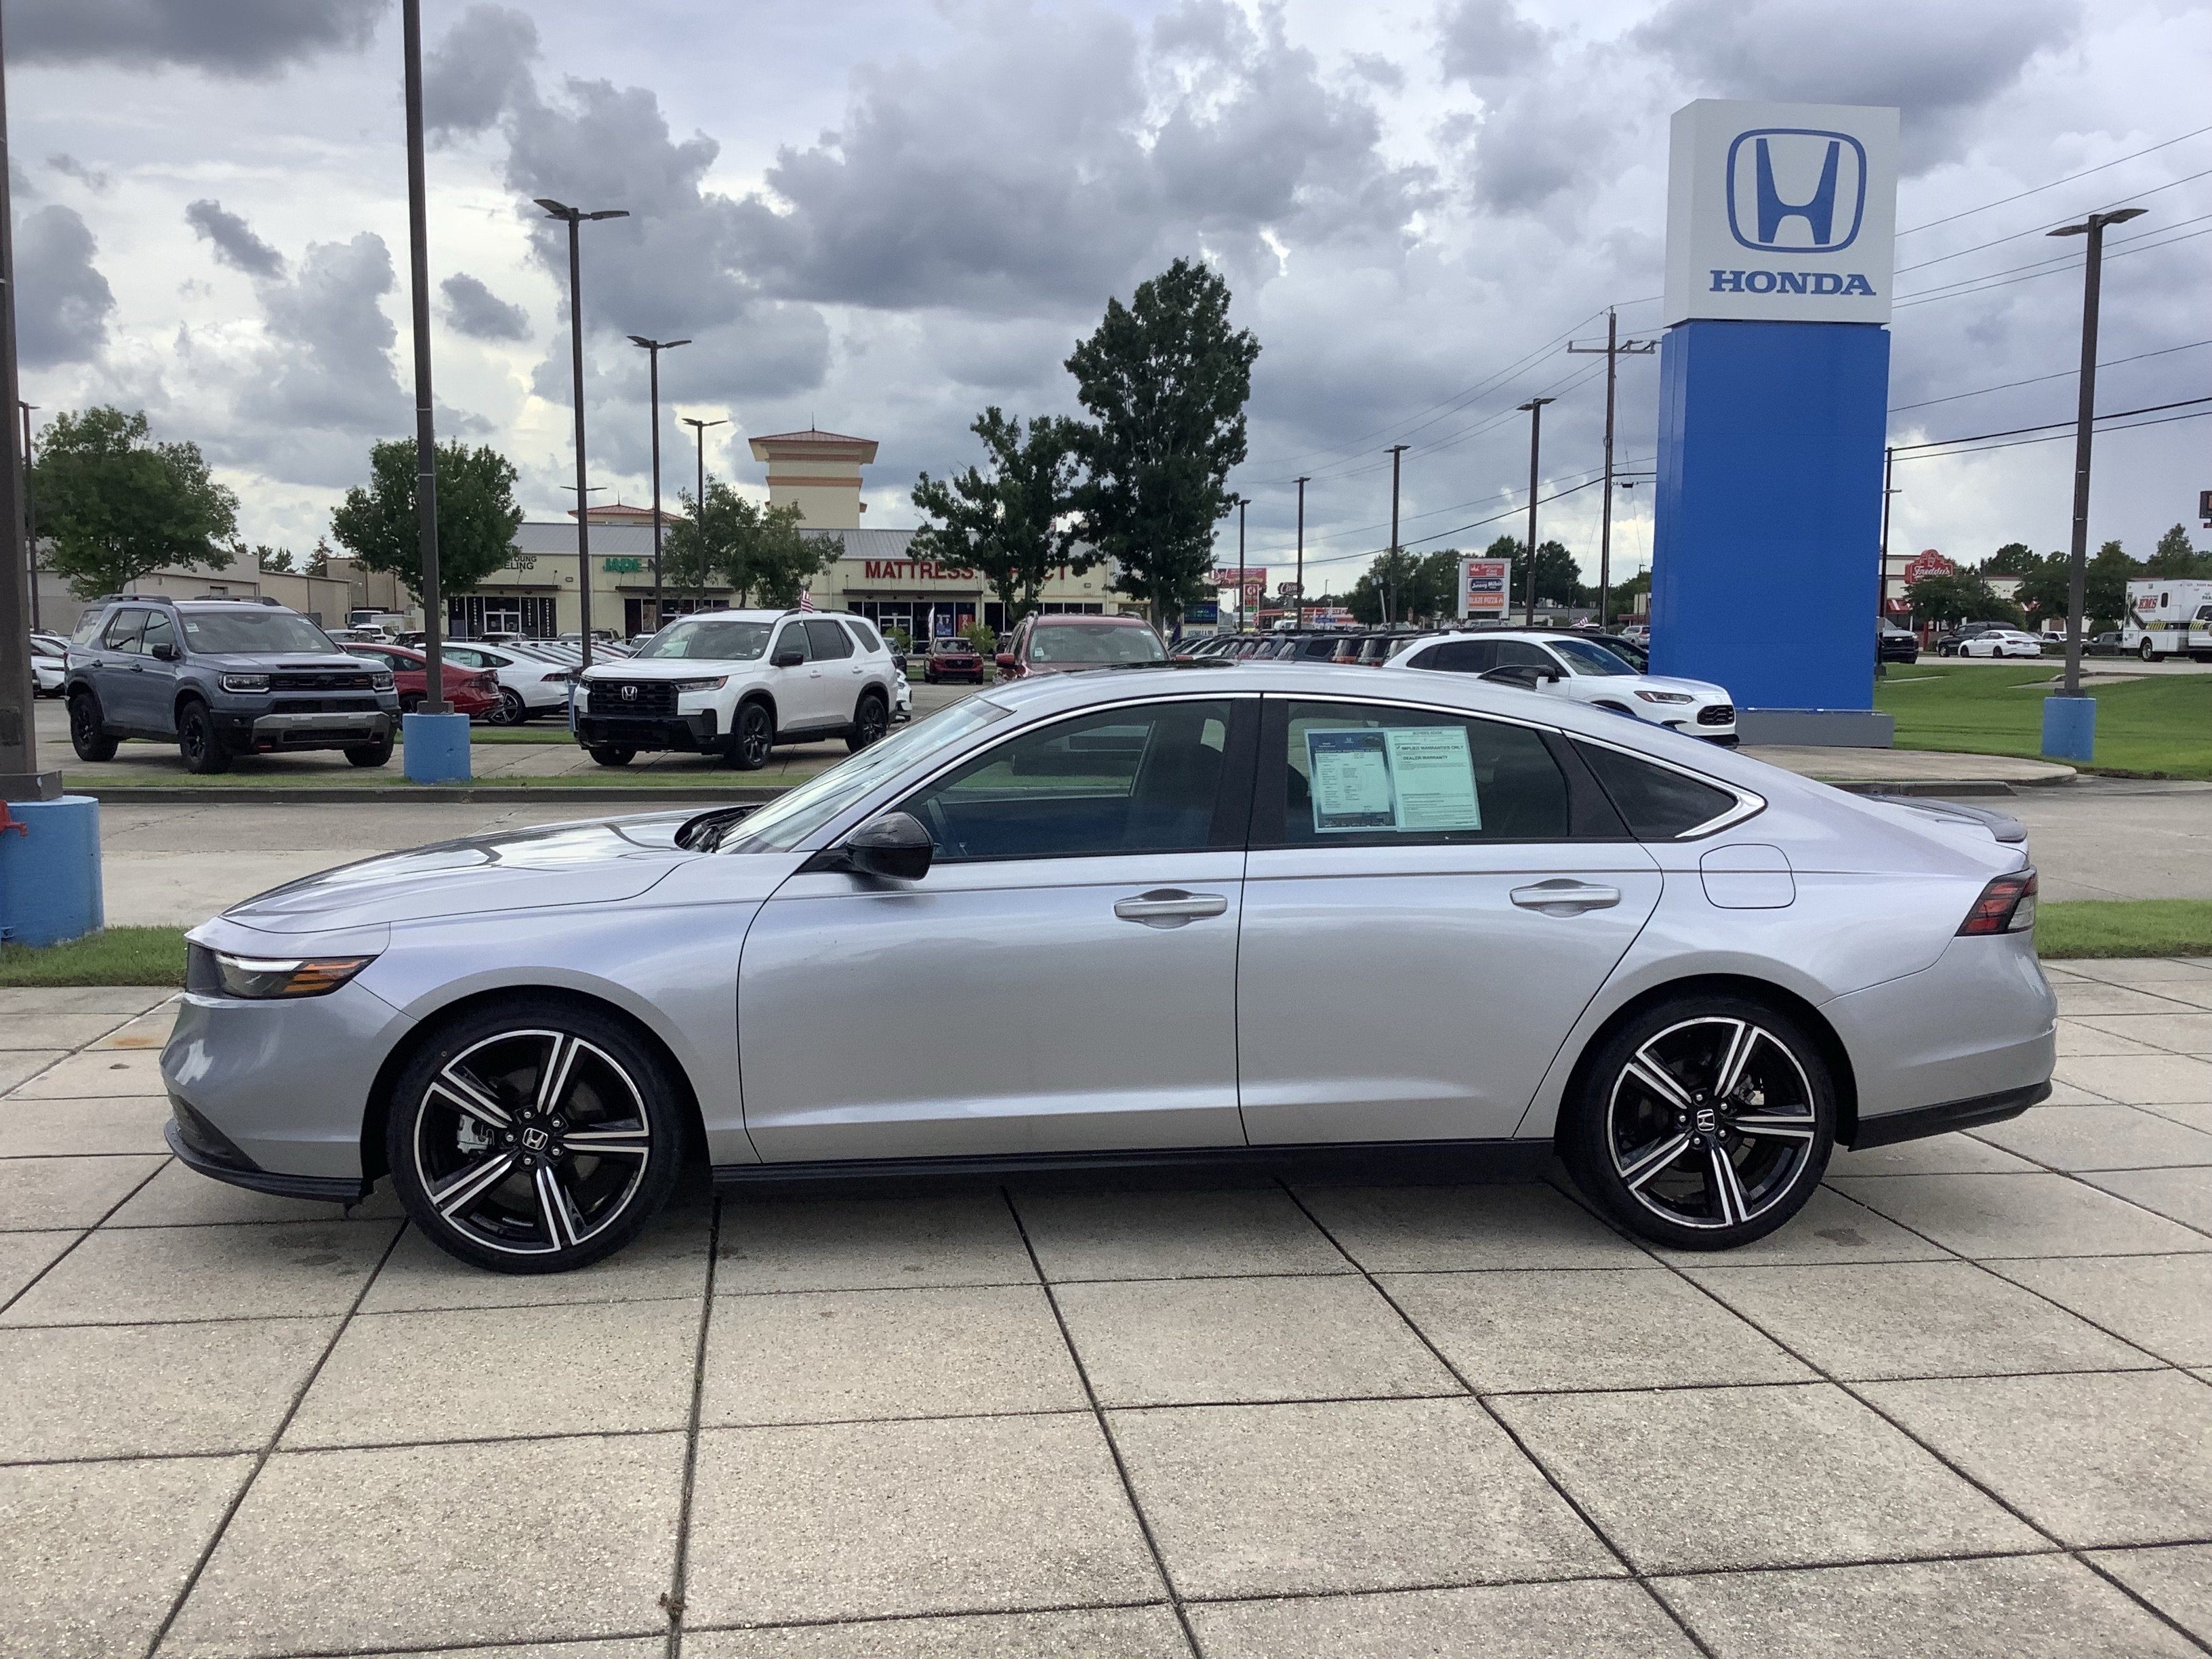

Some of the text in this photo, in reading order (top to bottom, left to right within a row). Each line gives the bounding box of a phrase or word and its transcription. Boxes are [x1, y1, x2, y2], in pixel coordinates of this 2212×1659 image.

[1709, 270, 1877, 295] HONDA
[603, 558, 643, 572] JADE
[865, 561, 974, 579] MATTRESS
